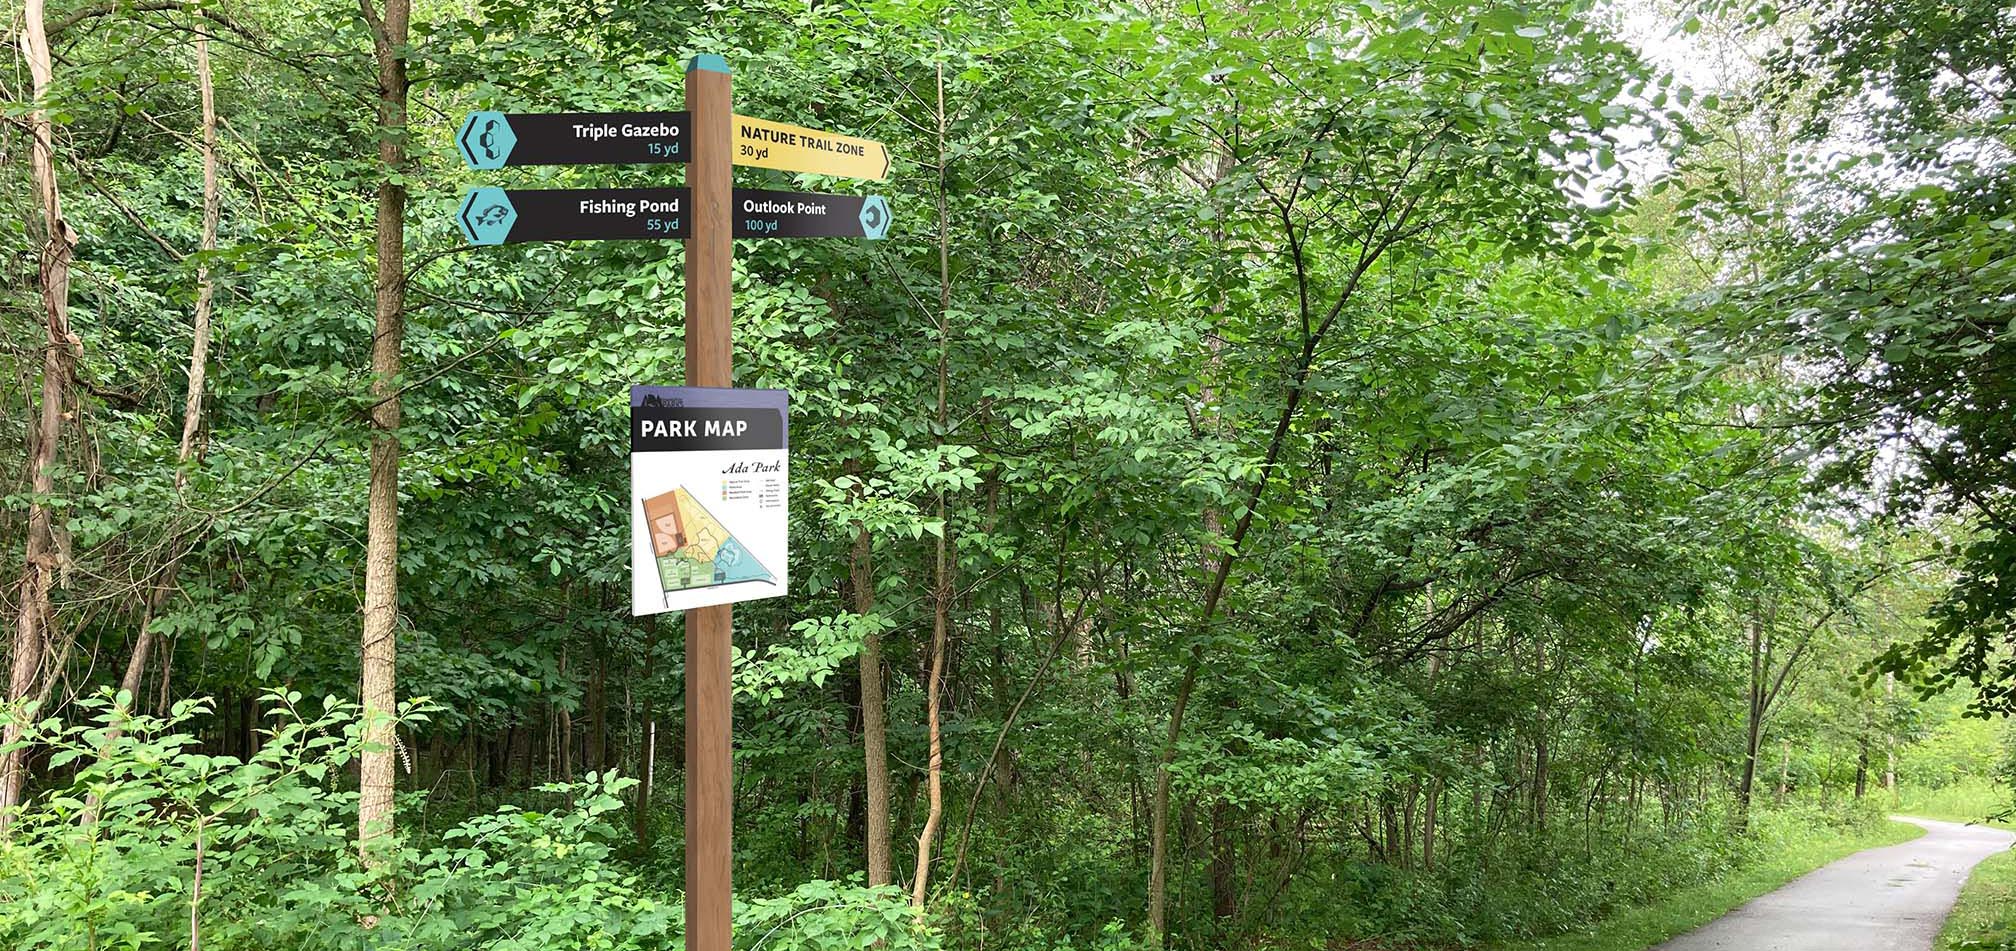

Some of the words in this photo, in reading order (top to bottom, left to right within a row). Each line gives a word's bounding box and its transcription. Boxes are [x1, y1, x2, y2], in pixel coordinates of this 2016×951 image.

[572, 123, 617, 141] Triple
[621, 122, 680, 137] Gazebo
[741, 125, 796, 145] NATURE
[799, 135, 833, 152] TRAIL
[836, 142, 865, 157] ZONE
[647, 143, 661, 154] 15
[664, 142, 679, 157] yd
[740, 145, 754, 156] 30
[755, 148, 769, 160] yd
[580, 199, 636, 217] Fishing
[639, 198, 679, 213] Pond
[743, 199, 795, 214] Outlook
[797, 202, 826, 215] Point
[647, 218, 661, 230] 55
[664, 218, 679, 233] yd
[745, 219, 764, 231] 100
[765, 219, 778, 233] yd
[641, 420, 697, 438] PARK
[704, 420, 747, 437] MAP
[722, 462, 749, 474] Ada
[751, 460, 781, 473] Park
